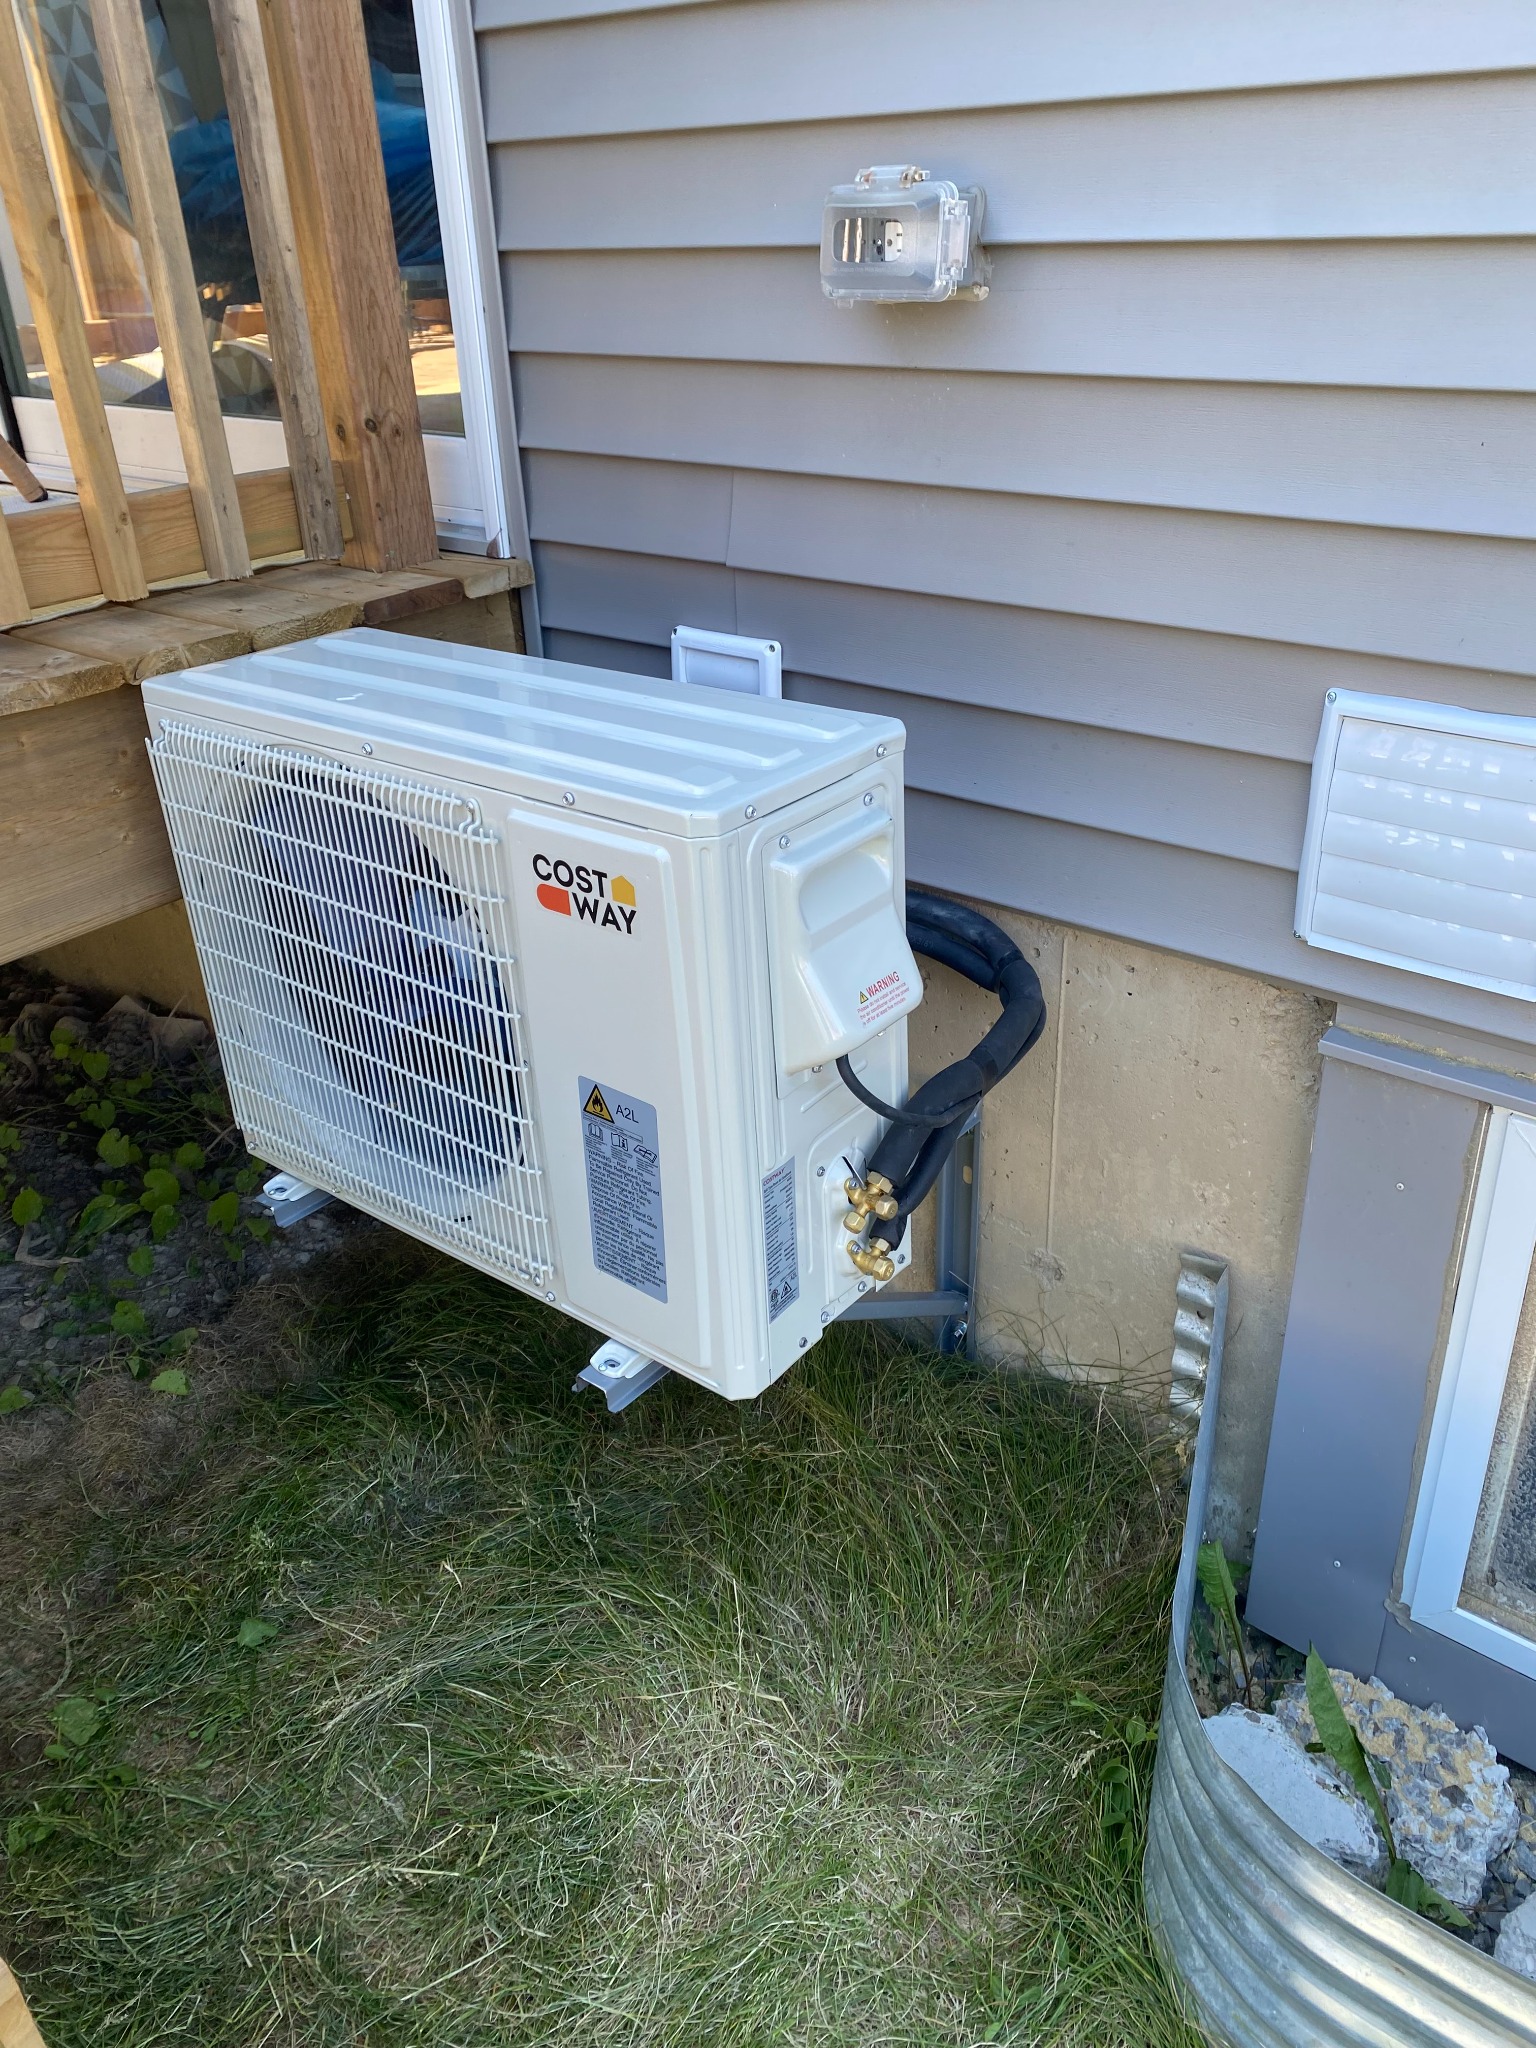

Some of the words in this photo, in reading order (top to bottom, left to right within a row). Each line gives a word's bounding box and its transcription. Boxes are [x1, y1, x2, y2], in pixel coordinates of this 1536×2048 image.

[532, 854, 607, 898] COST
[571, 891, 637, 935] WAY
[866, 971, 900, 998] WARNING
[616, 1105, 639, 1124] A2L
